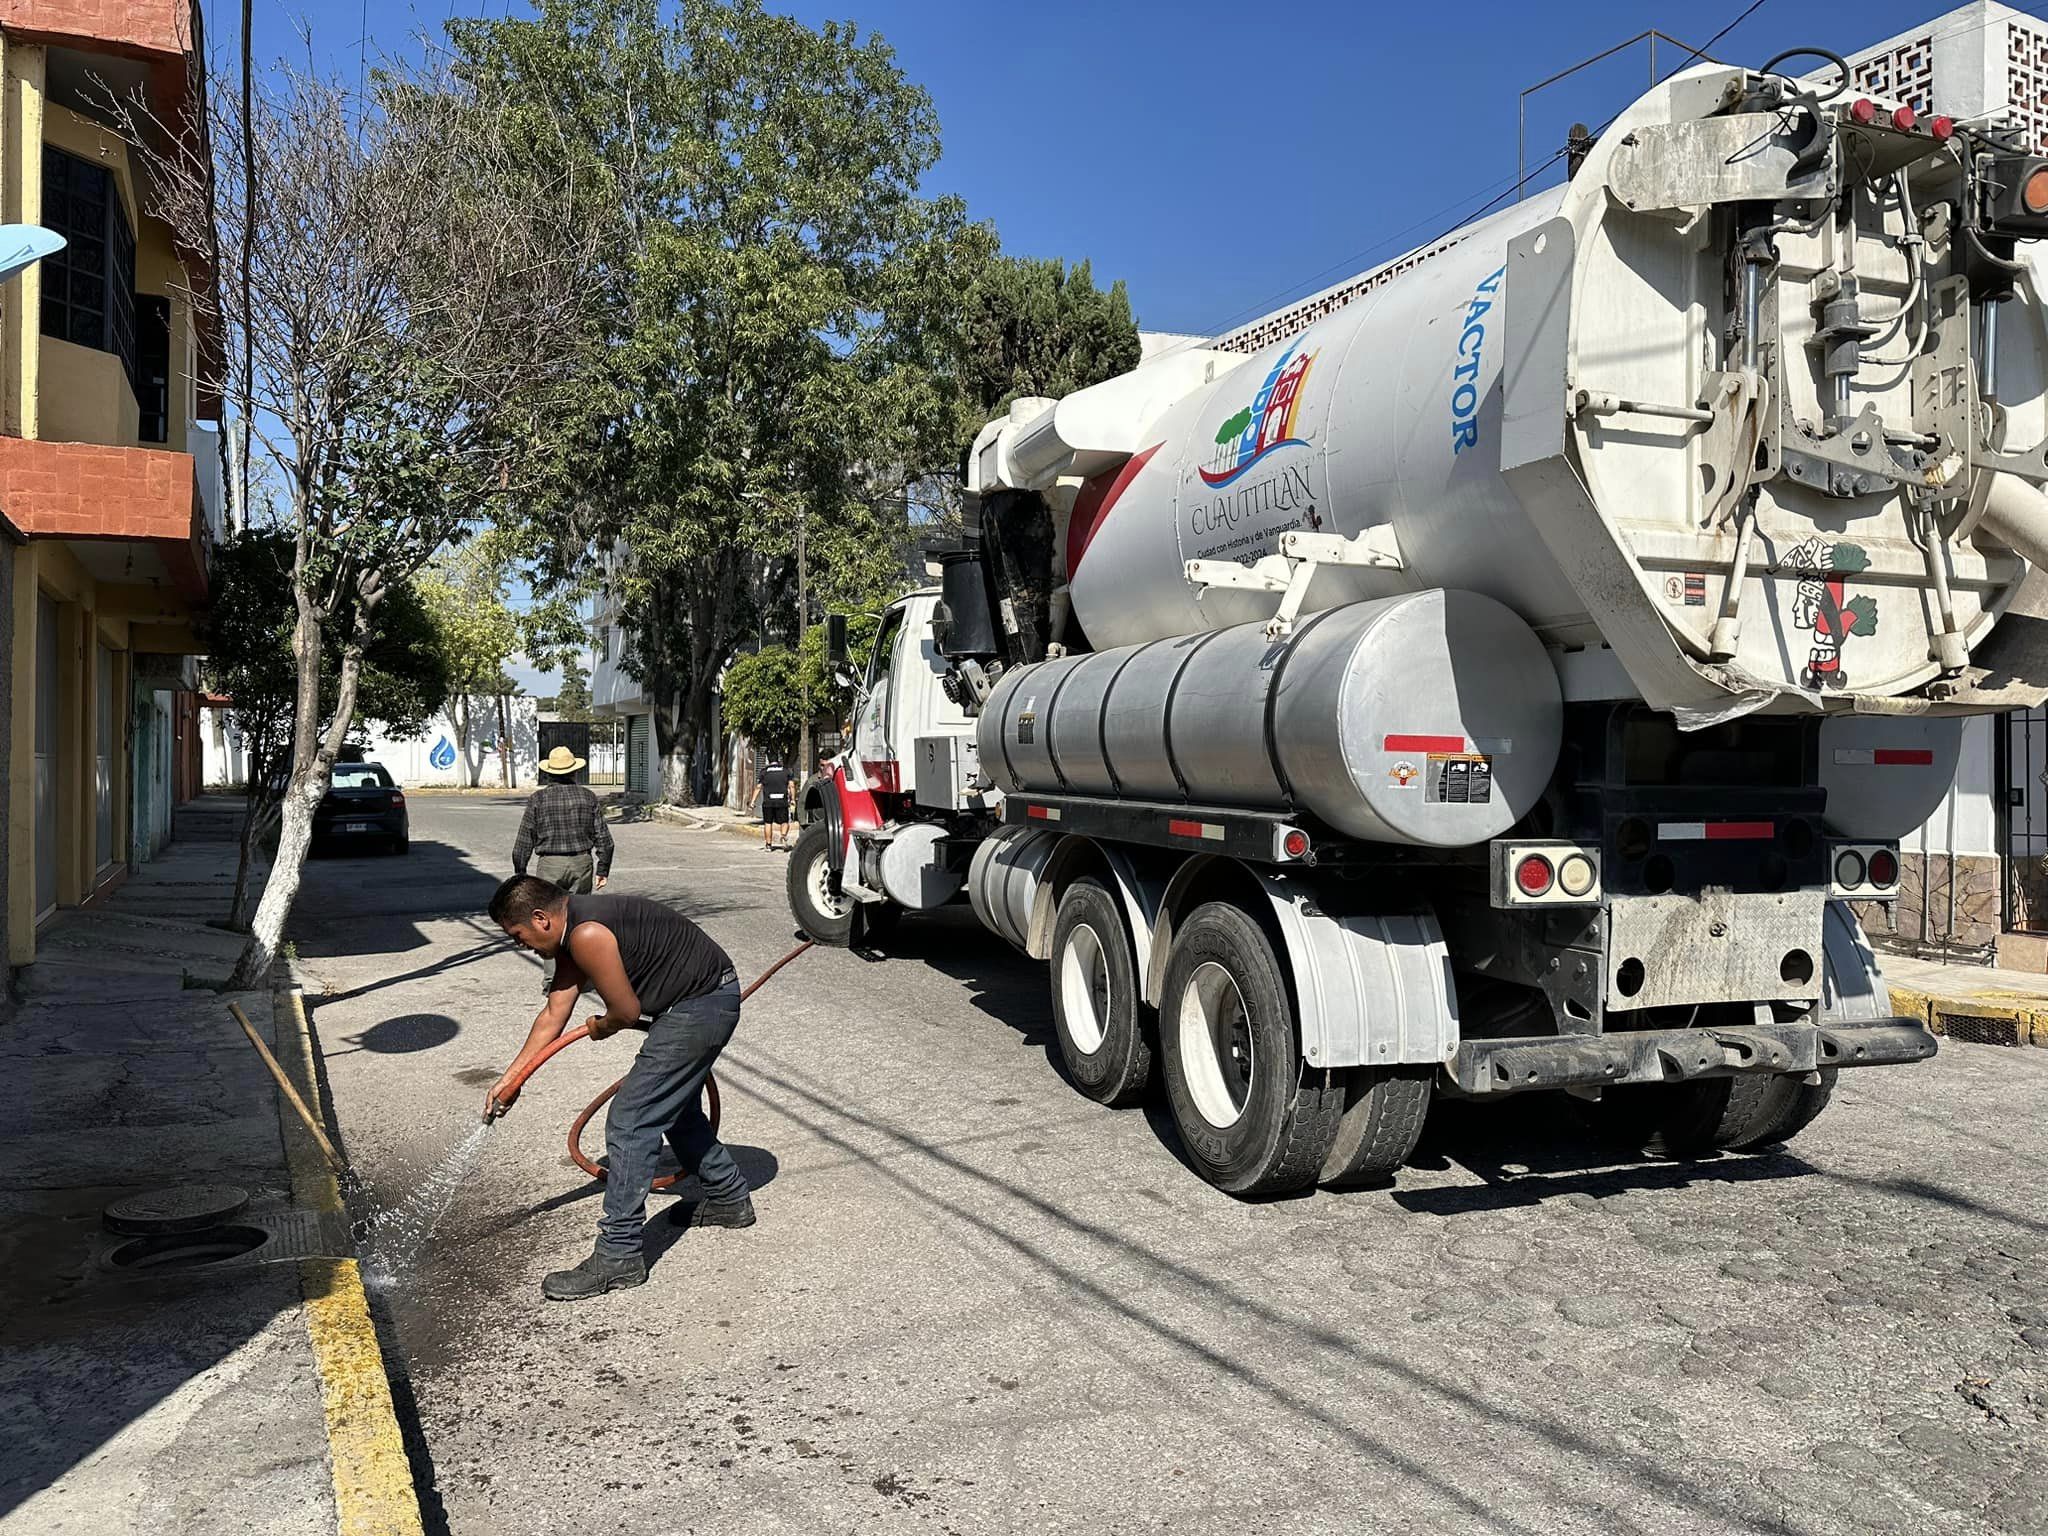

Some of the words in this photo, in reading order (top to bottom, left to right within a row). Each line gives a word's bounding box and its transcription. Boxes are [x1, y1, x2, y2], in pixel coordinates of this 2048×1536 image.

[1452, 264, 1508, 455] VACTOR
[1197, 545, 1217, 559] Ciudad
[1216, 543, 1228, 553] con
[1255, 530, 1264, 541] de
